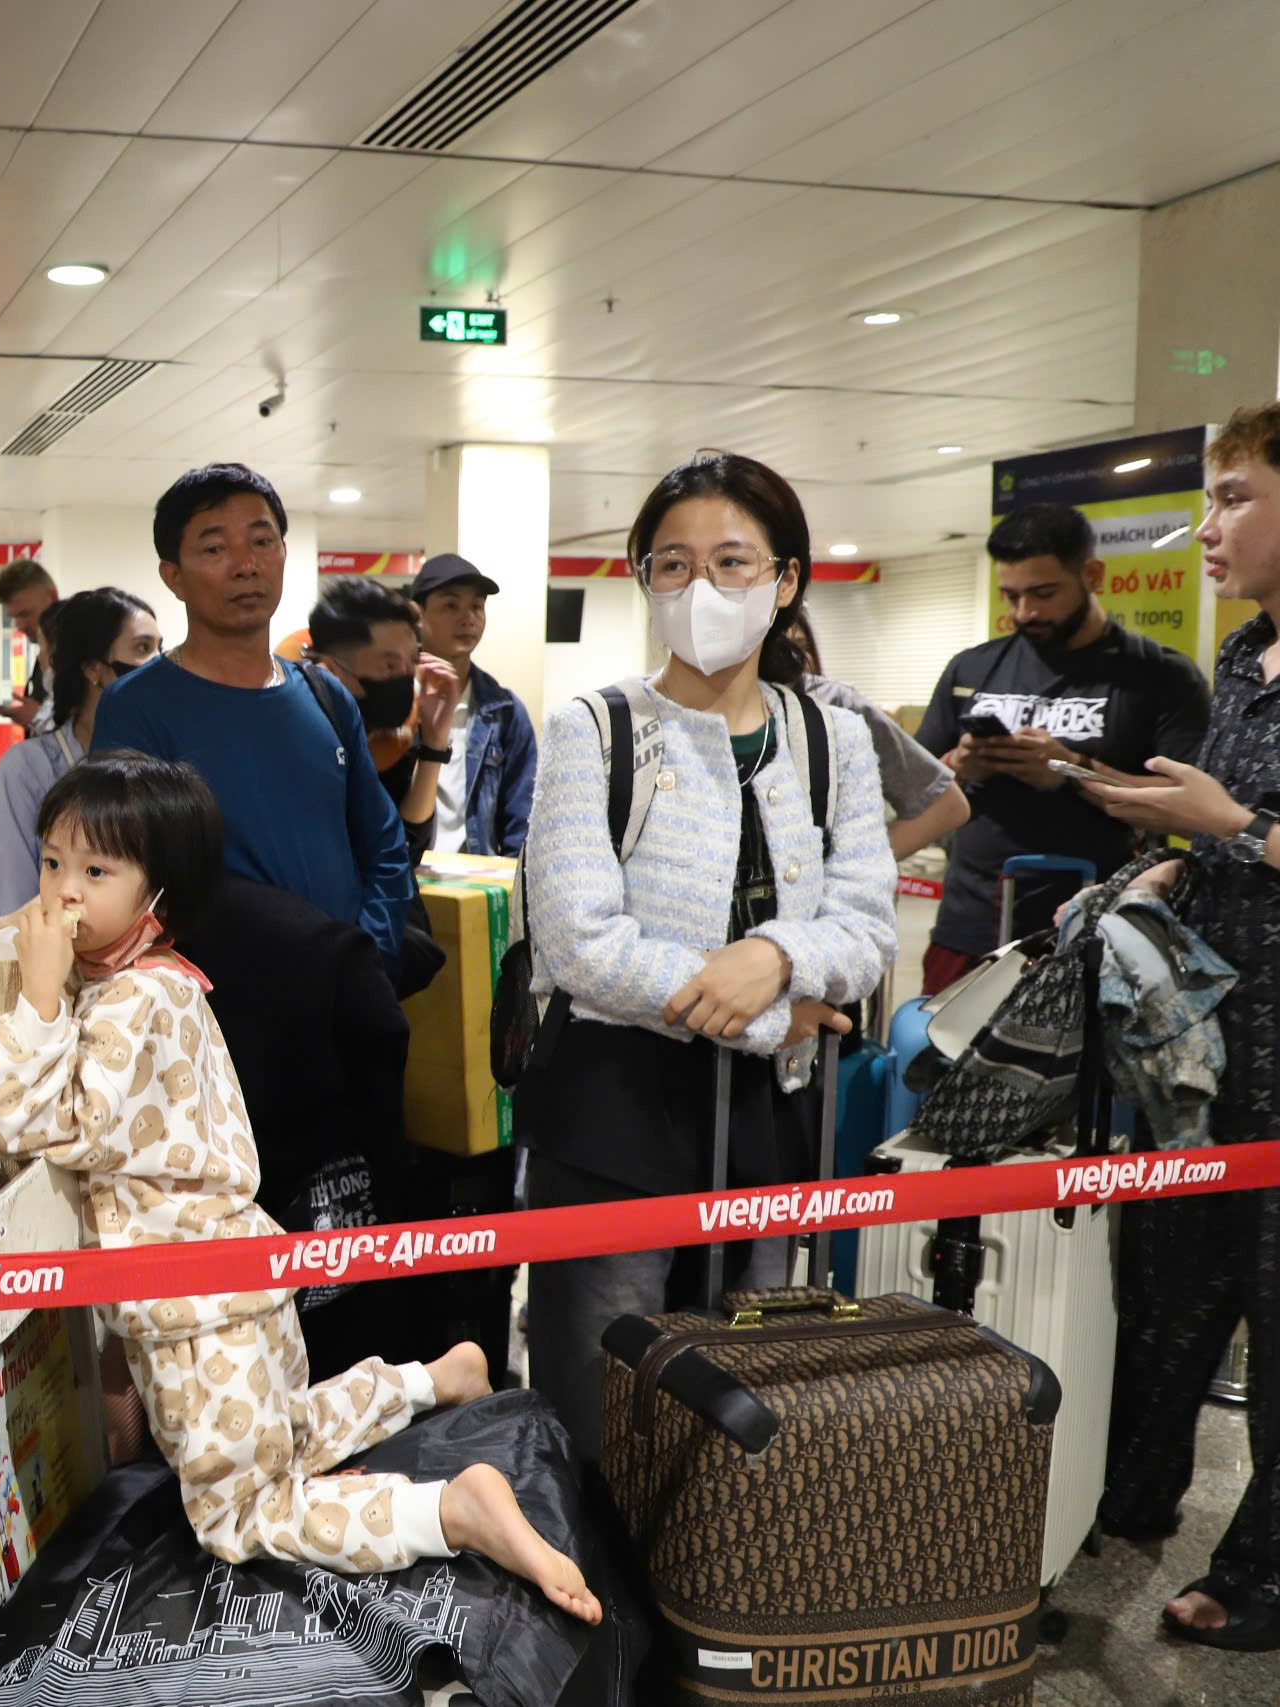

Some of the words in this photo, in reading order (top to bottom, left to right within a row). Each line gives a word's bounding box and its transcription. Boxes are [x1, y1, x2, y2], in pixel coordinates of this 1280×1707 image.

[1135, 608, 1184, 630] trong
[751, 1636, 938, 1688] CHRISTIAN
[951, 1623, 1020, 1673] DIOR
